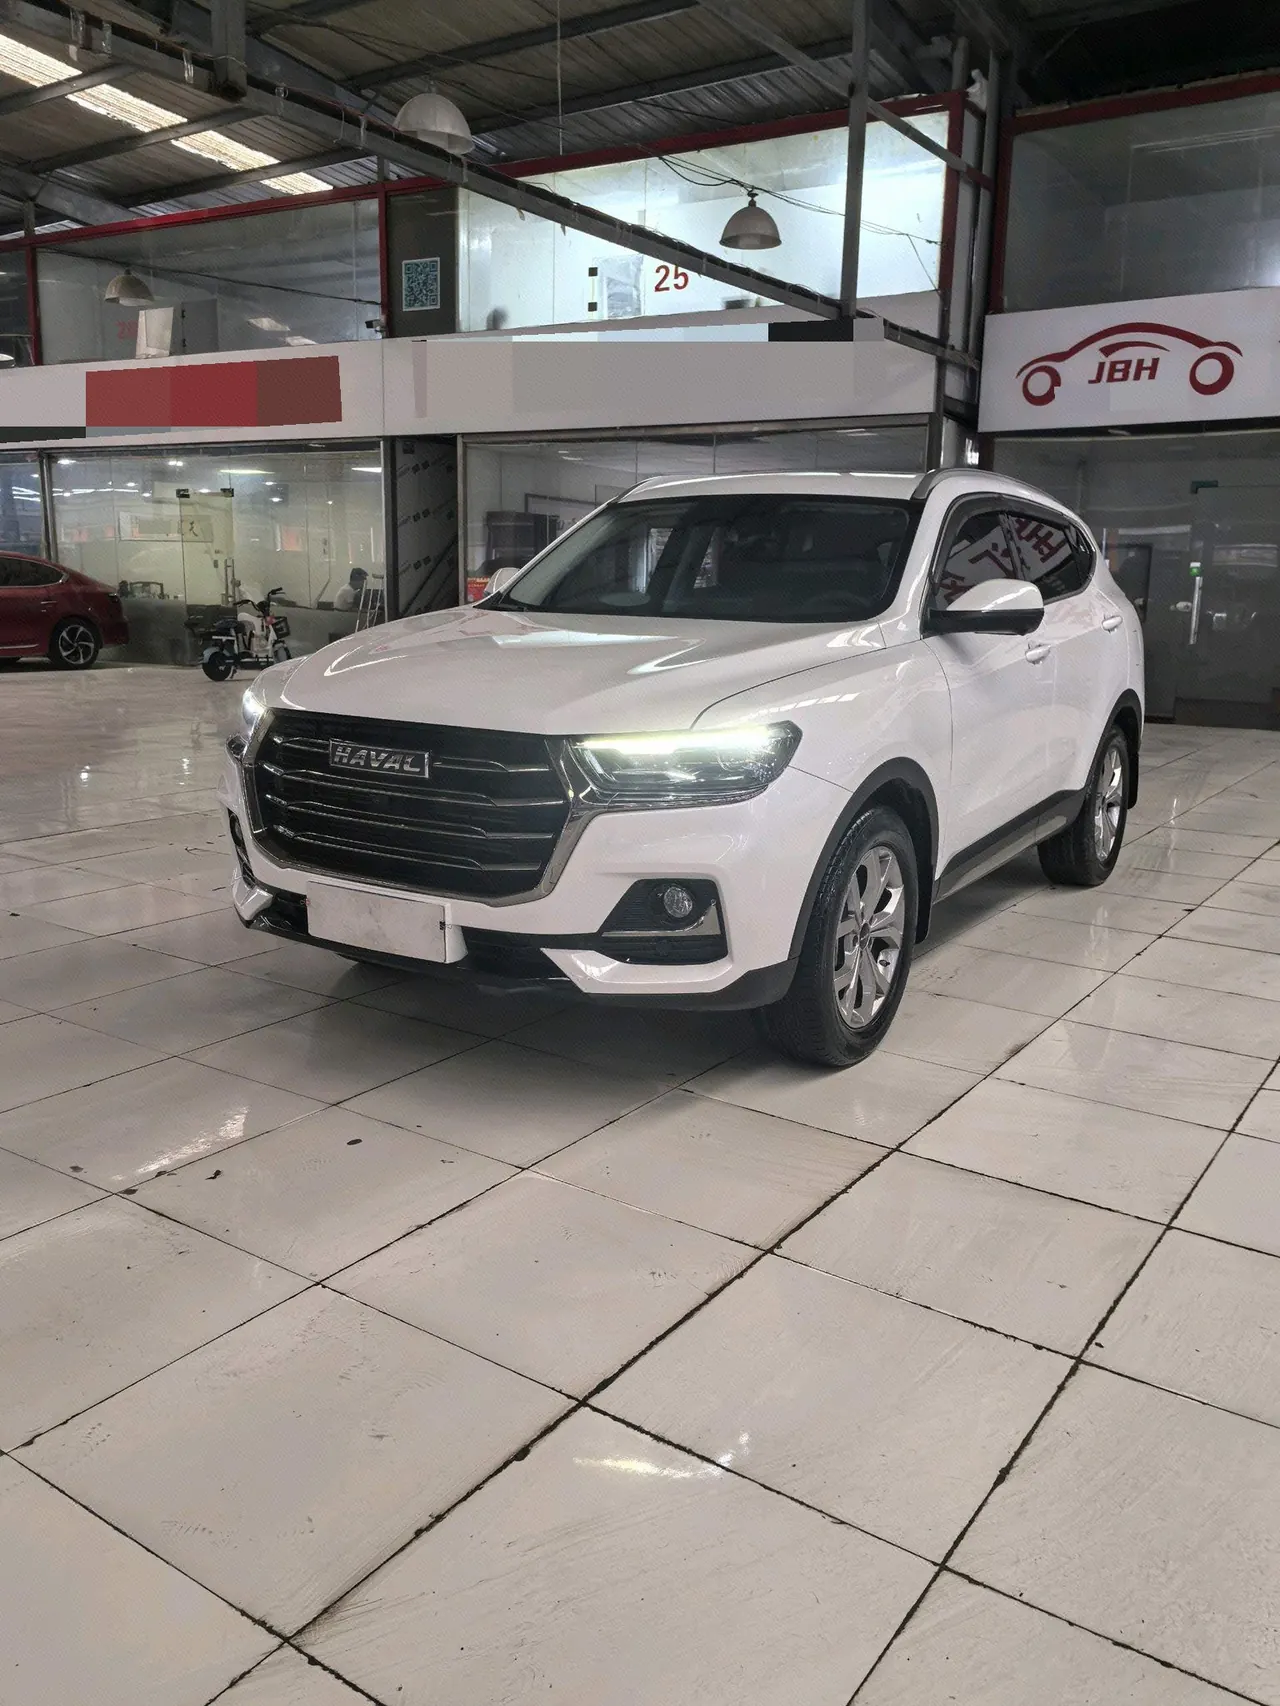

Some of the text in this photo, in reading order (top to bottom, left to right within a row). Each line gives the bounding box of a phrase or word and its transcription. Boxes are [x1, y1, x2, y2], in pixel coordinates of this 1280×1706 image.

[654, 264, 689, 292] 25
[1087, 357, 1160, 384] JBH
[333, 746, 420, 772] HAVAL
